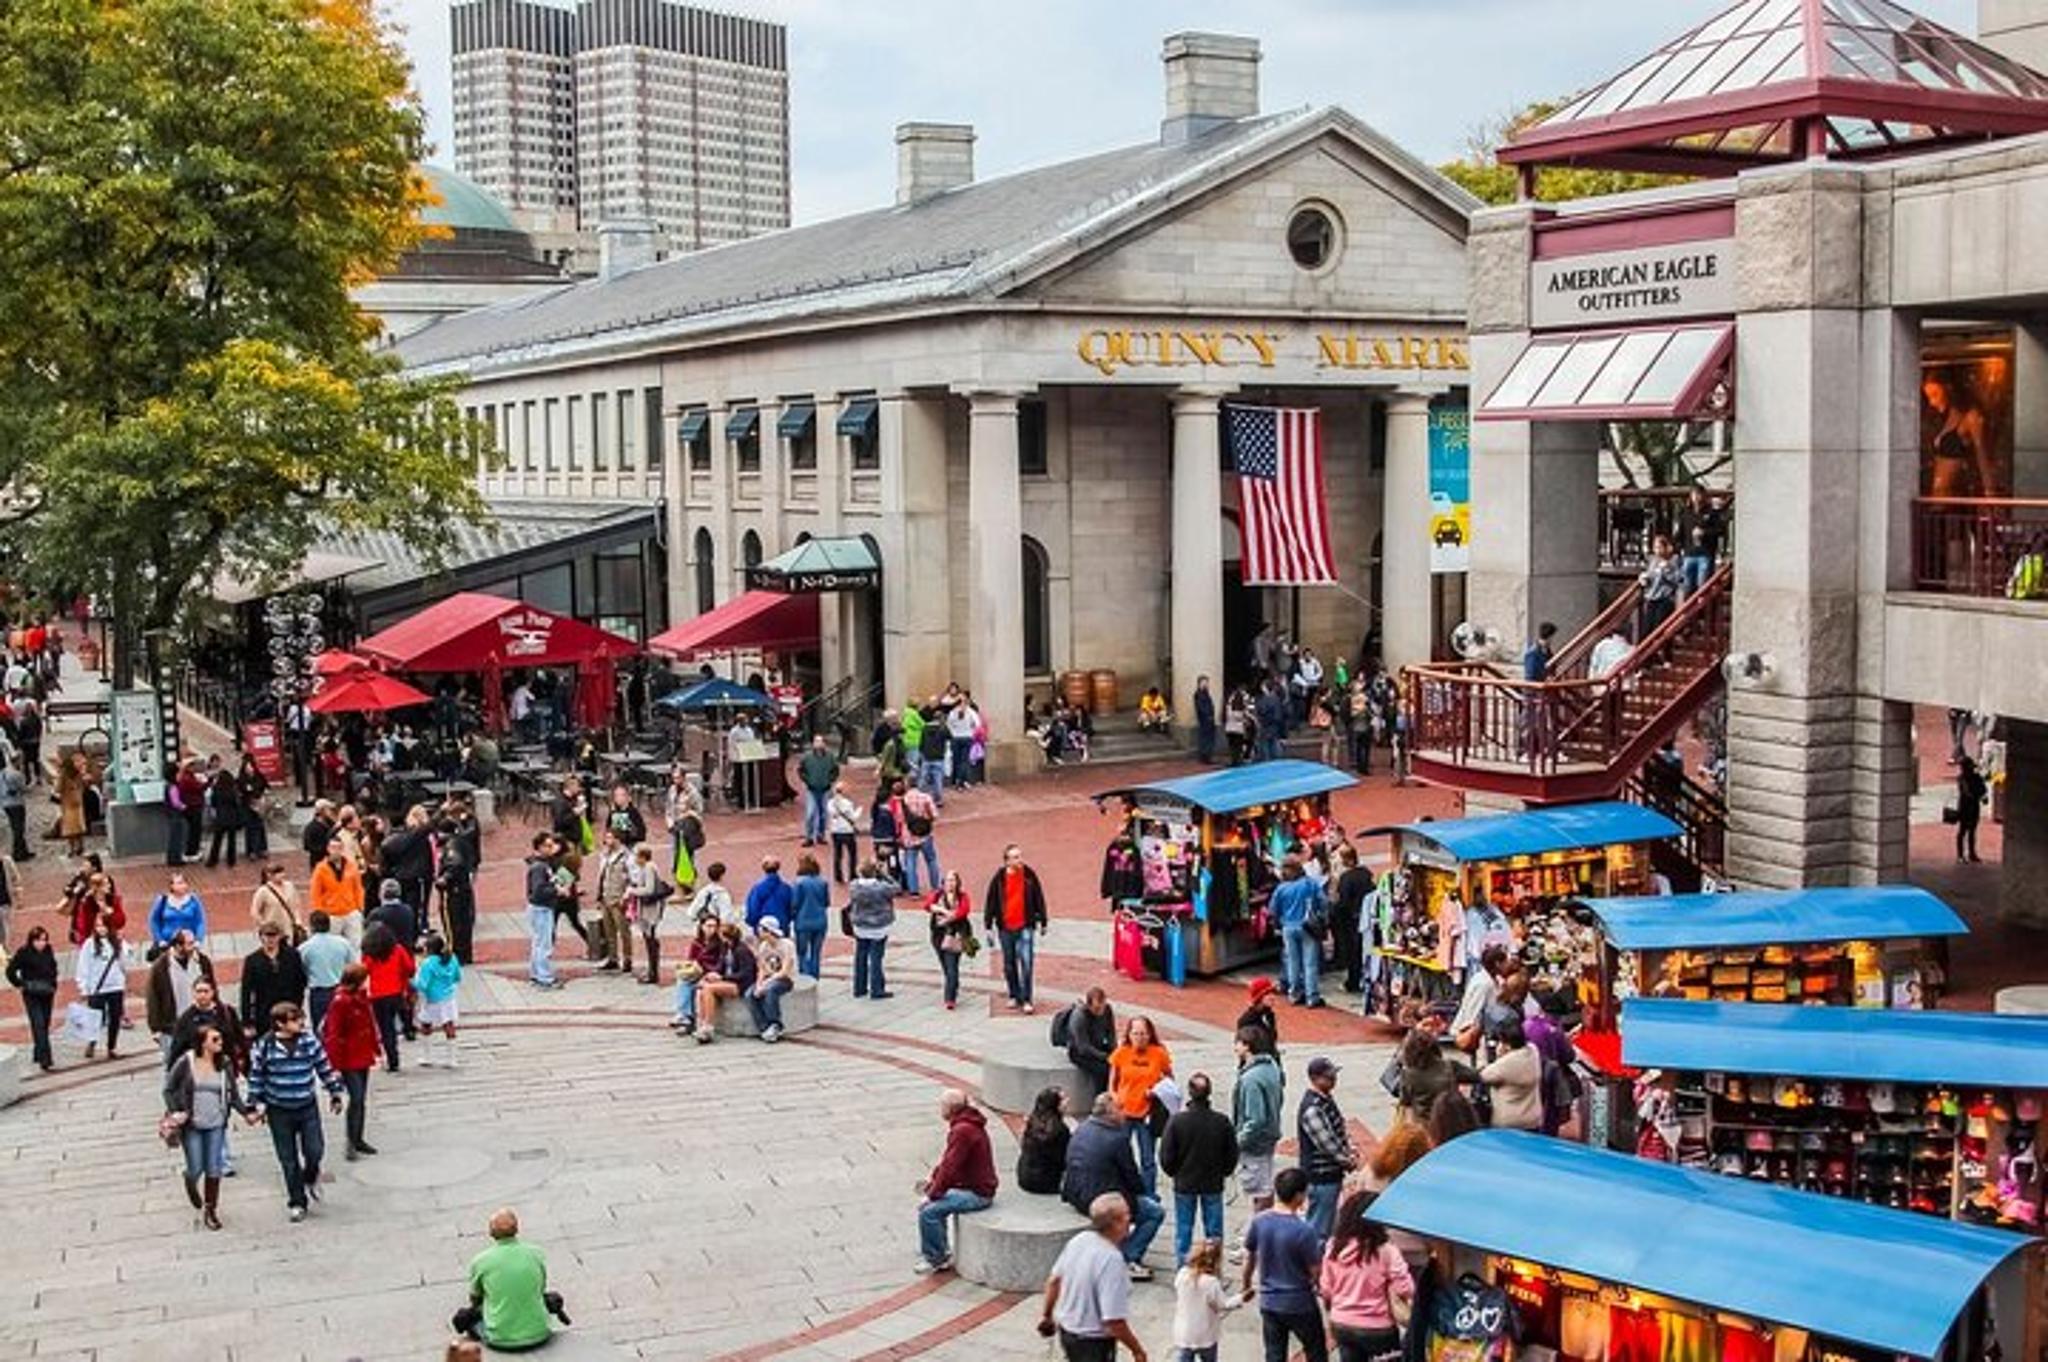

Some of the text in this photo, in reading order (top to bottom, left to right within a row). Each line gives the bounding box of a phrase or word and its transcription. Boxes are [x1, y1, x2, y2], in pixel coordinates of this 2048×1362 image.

[1548, 254, 1717, 292] AMERICAN EAGLE
[1578, 286, 1682, 311] OUTFITTERS
[1078, 327, 1283, 376] QUINCY
